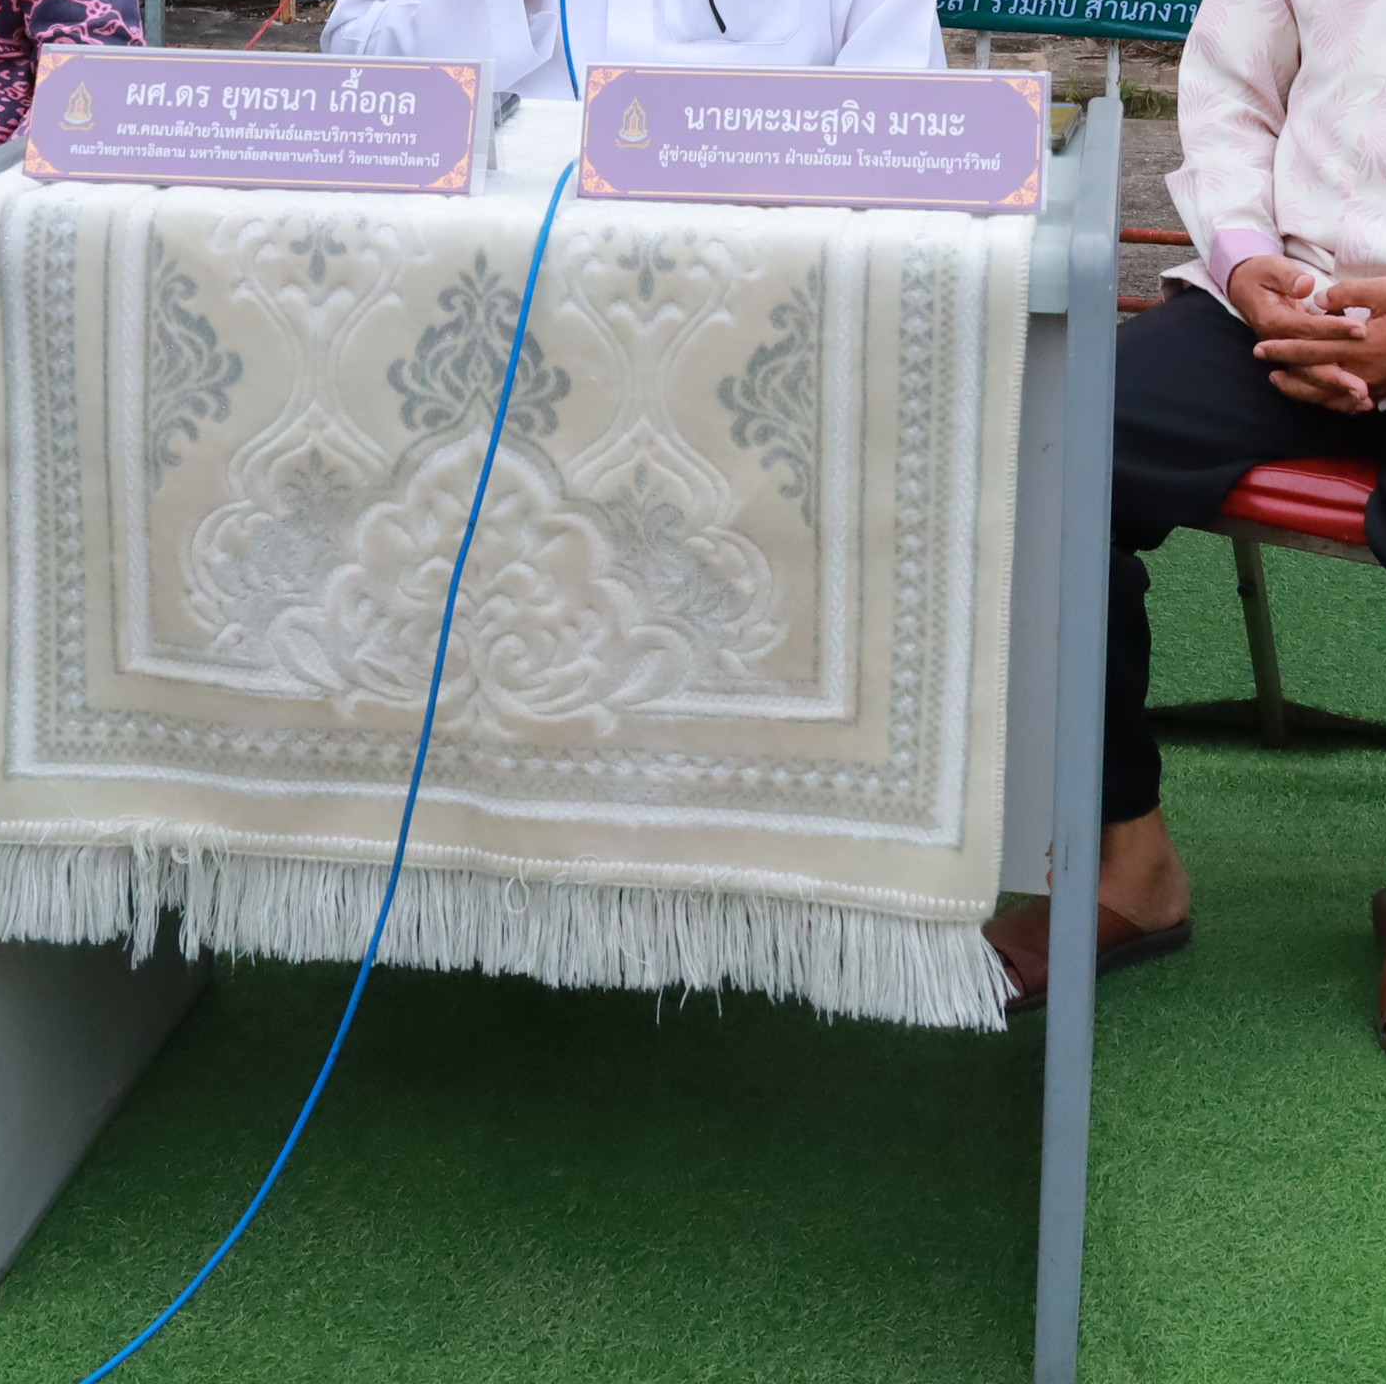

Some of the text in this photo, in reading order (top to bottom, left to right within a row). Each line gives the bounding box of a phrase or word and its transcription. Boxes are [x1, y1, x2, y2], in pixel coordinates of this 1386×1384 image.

[125, 68, 416, 126] ผศ.ดร ยุทธนา เกื้อกูล
[684, 99, 965, 146] นายหะมะสูดิง มามะ
[69, 141, 186, 159] คณะวิทยาการอิสลาม
[658, 143, 781, 169] ผู้ช่วยผู้อำนวยการ
